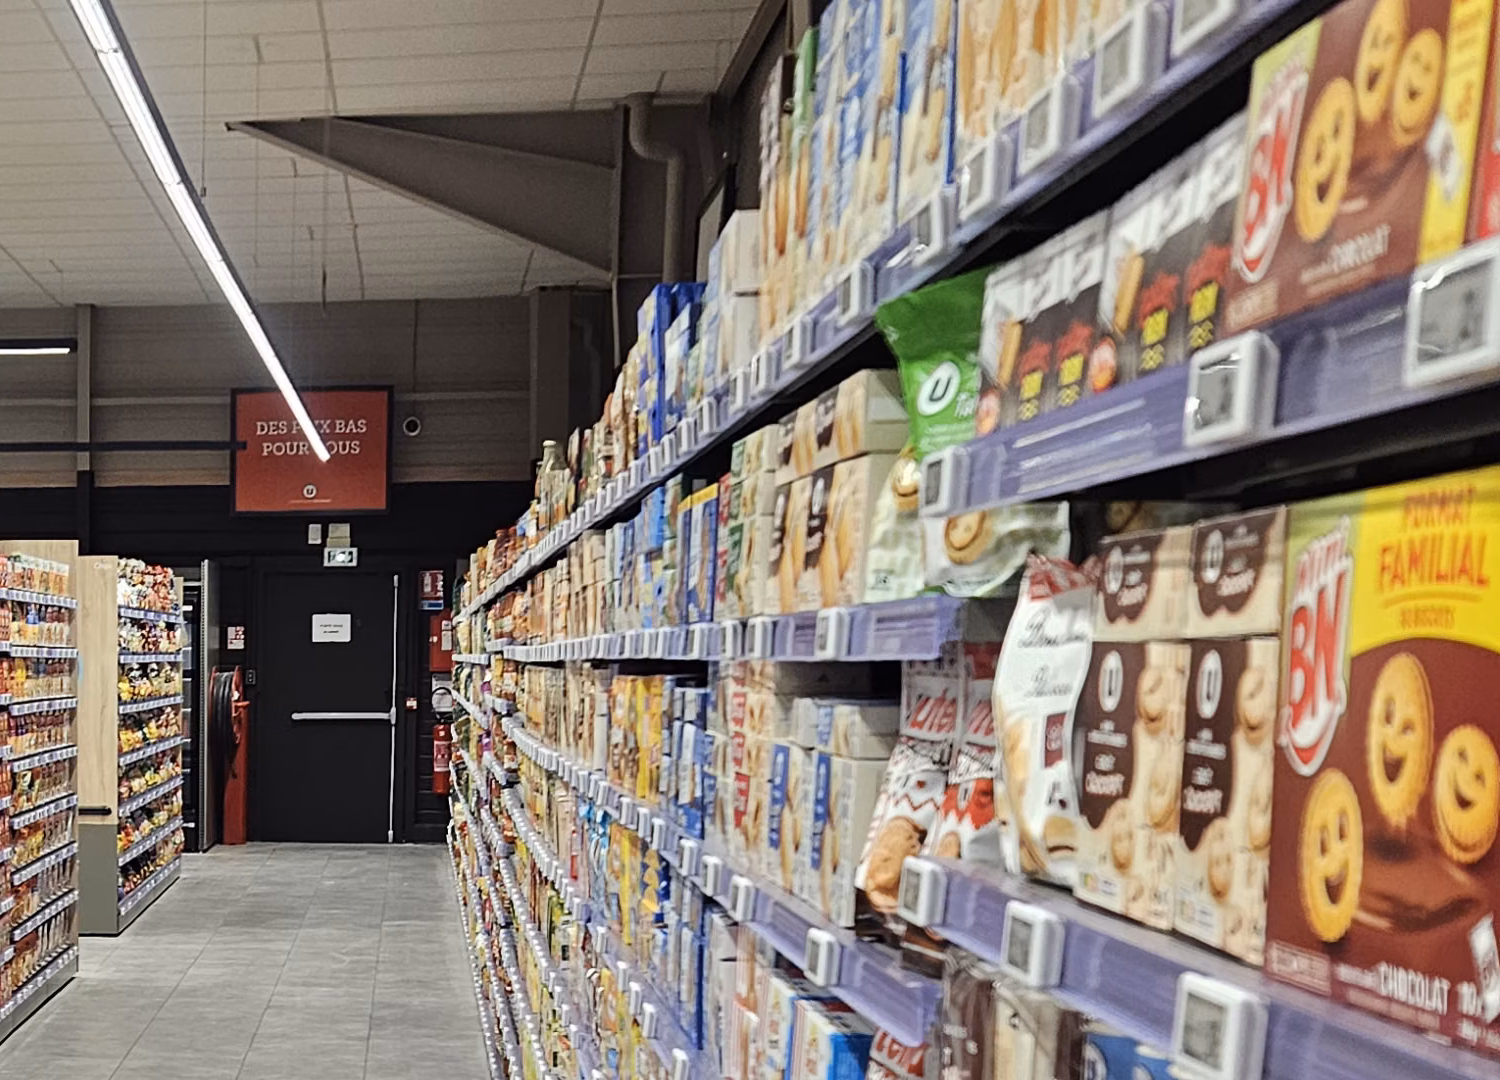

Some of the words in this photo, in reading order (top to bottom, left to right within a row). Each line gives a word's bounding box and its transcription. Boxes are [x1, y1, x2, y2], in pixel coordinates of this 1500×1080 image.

[256, 421, 287, 435] DES
[292, 420, 331, 434] PX
[335, 419, 367, 433] BAS
[262, 442, 309, 456] POUR
[1378, 533, 1489, 592] FAMILIAL
[1290, 570, 1346, 729] BN
[1377, 960, 1451, 1016] CHOCOLAT
